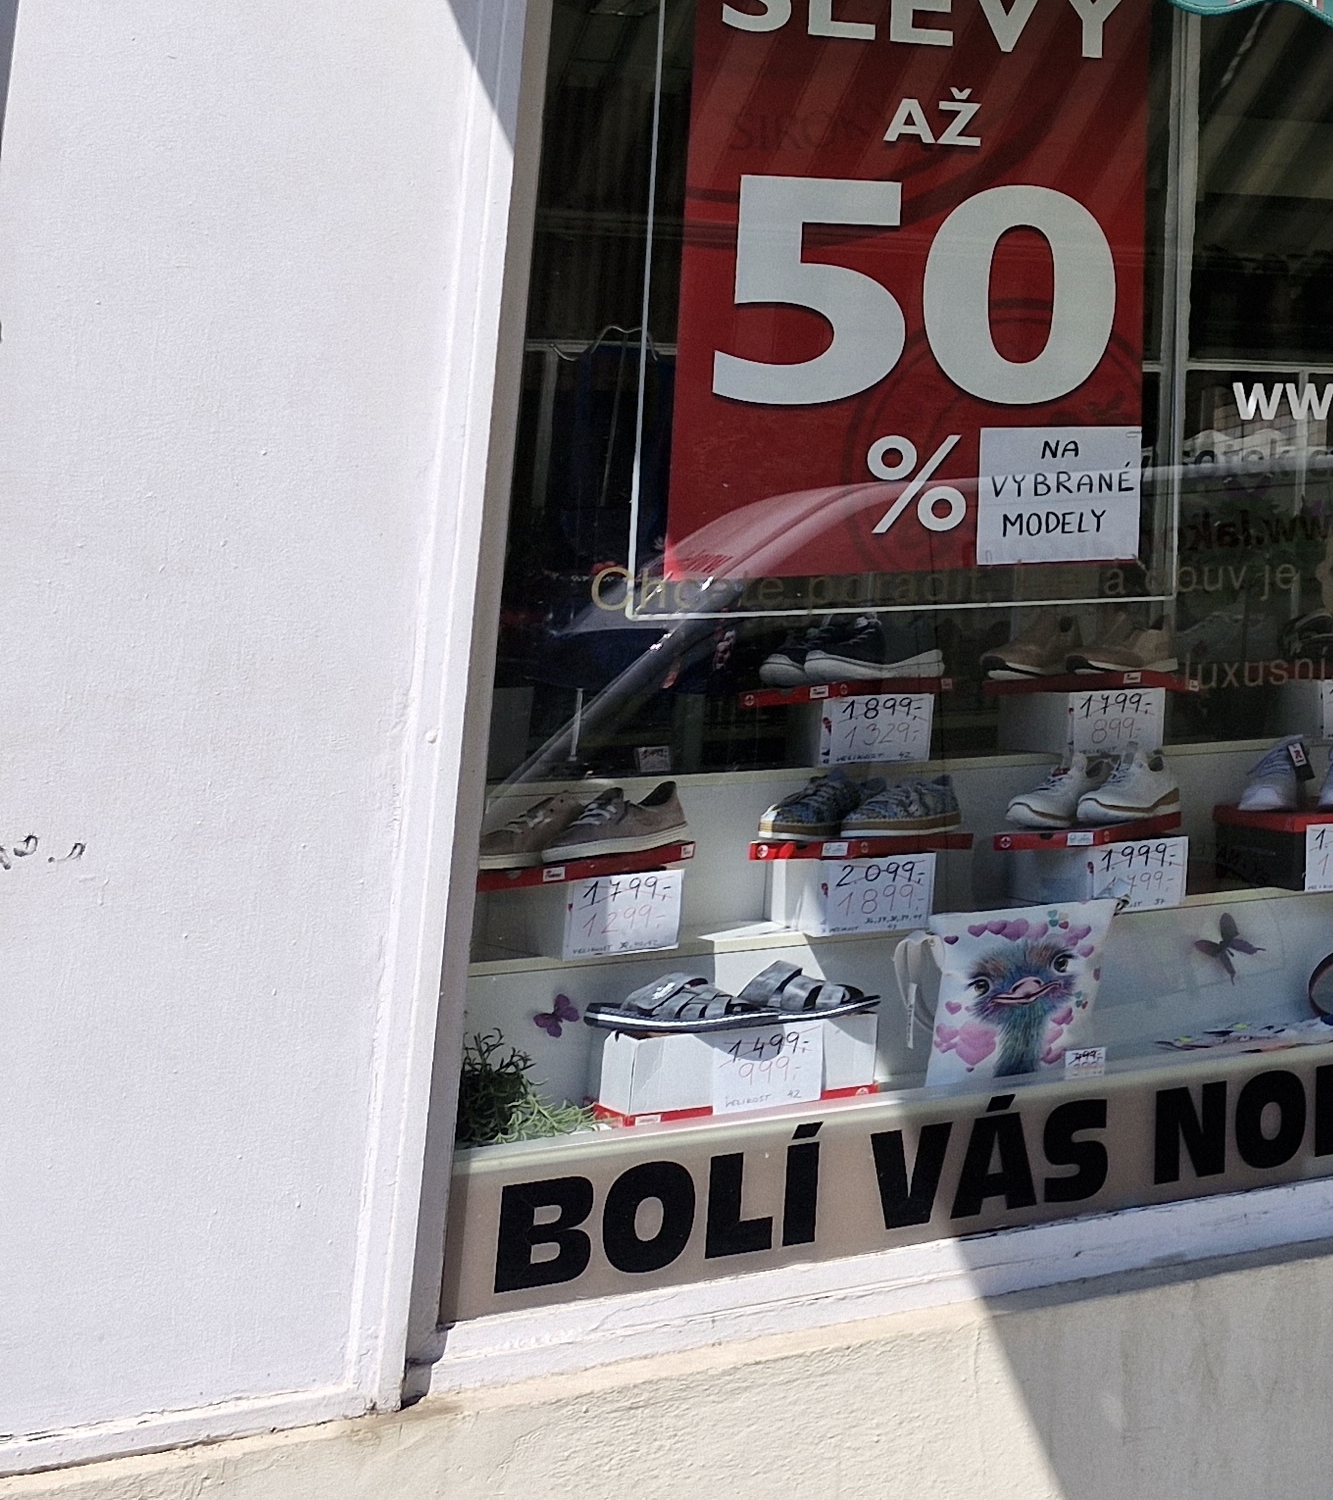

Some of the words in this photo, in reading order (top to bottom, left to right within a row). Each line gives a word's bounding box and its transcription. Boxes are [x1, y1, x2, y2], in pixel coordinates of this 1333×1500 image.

[883, 87, 982, 147] AŽ
[712, 174, 1117, 406] 50
[1041, 438, 1080, 460] NA
[867, 435, 966, 534] %
[990, 463, 1135, 498] VYBRANÉ
[1001, 508, 1107, 538] MODELY
[1260, 562, 1297, 601] je
[493, 1120, 824, 1294] BOLÍ
[870, 1093, 1109, 1230] VÁS
